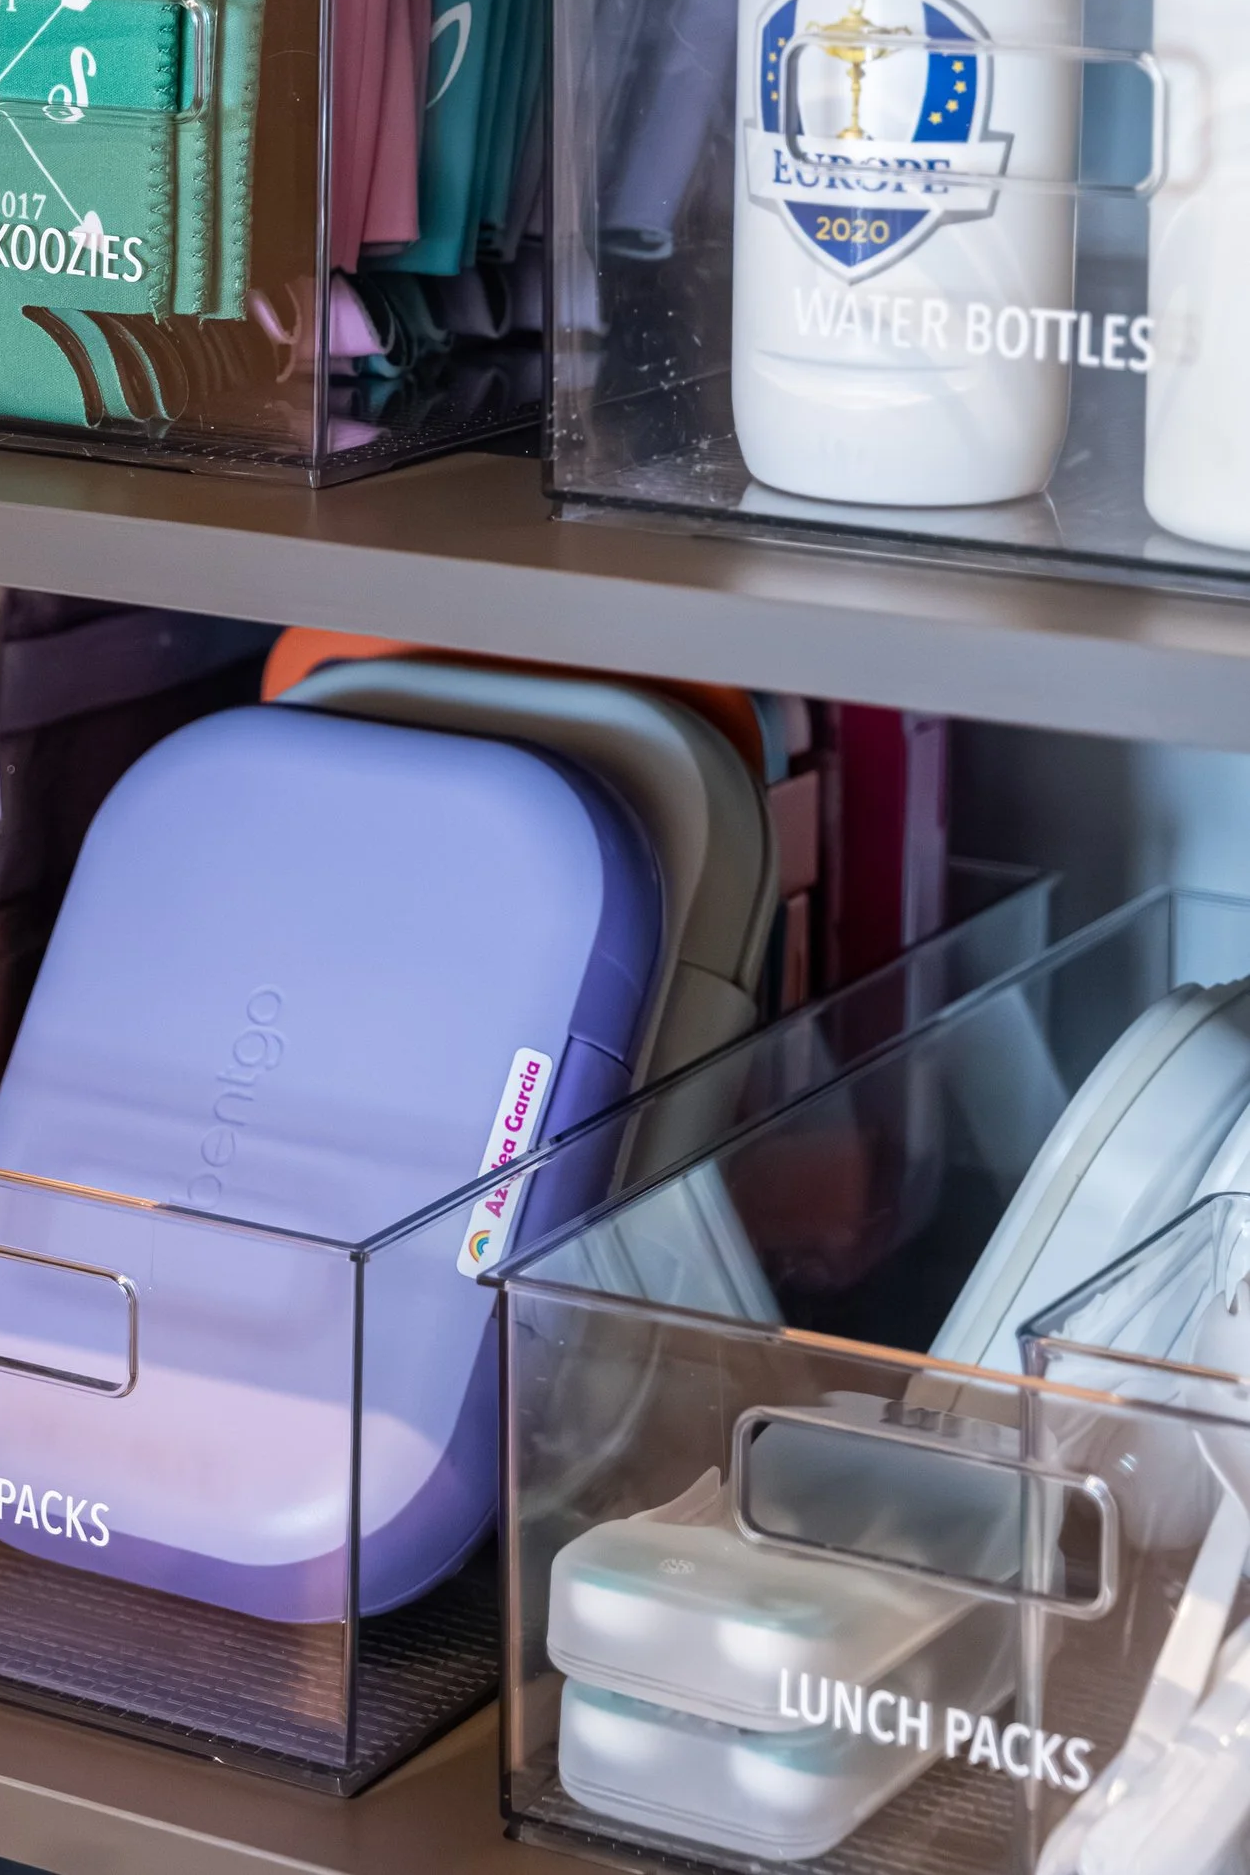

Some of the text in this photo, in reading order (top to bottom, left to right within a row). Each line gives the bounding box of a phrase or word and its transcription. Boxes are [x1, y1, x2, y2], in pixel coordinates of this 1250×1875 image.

[772, 148, 951, 194] EUROPE
[815, 216, 890, 245] 2020
[795, 287, 1156, 373] WATER BOTTLES
[504, 1059, 542, 1134] Garcia
[778, 1667, 1095, 1793] LUNCH PACKS
